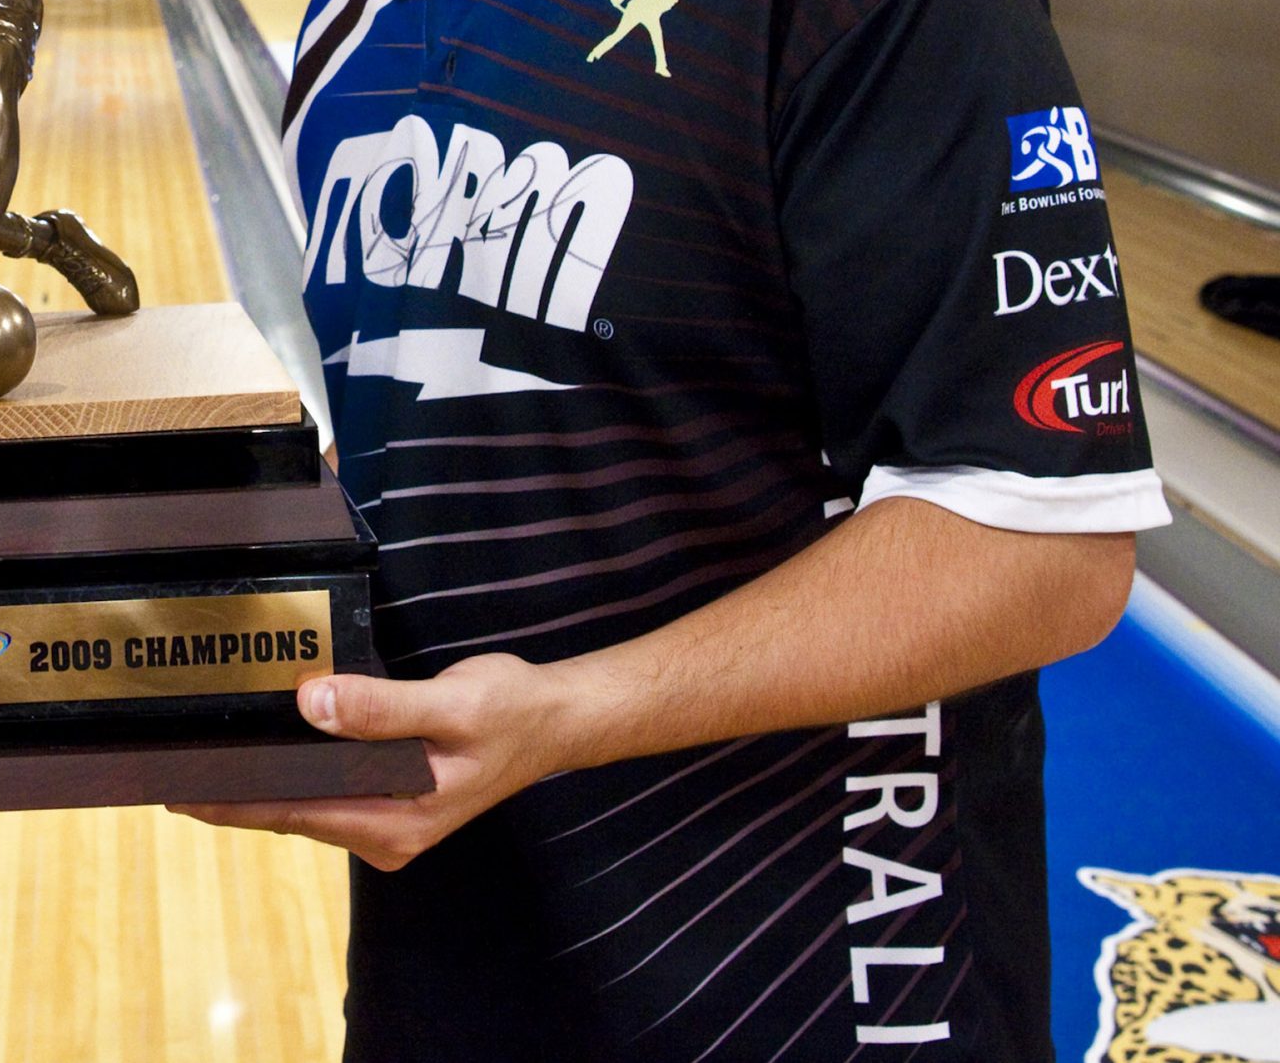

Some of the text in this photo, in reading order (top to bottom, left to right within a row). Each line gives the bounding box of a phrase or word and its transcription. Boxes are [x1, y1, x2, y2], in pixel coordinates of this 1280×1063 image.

[1018, 190, 1077, 212] BOWLING
[29, 628, 320, 673] 2009 CHAMPIONS
